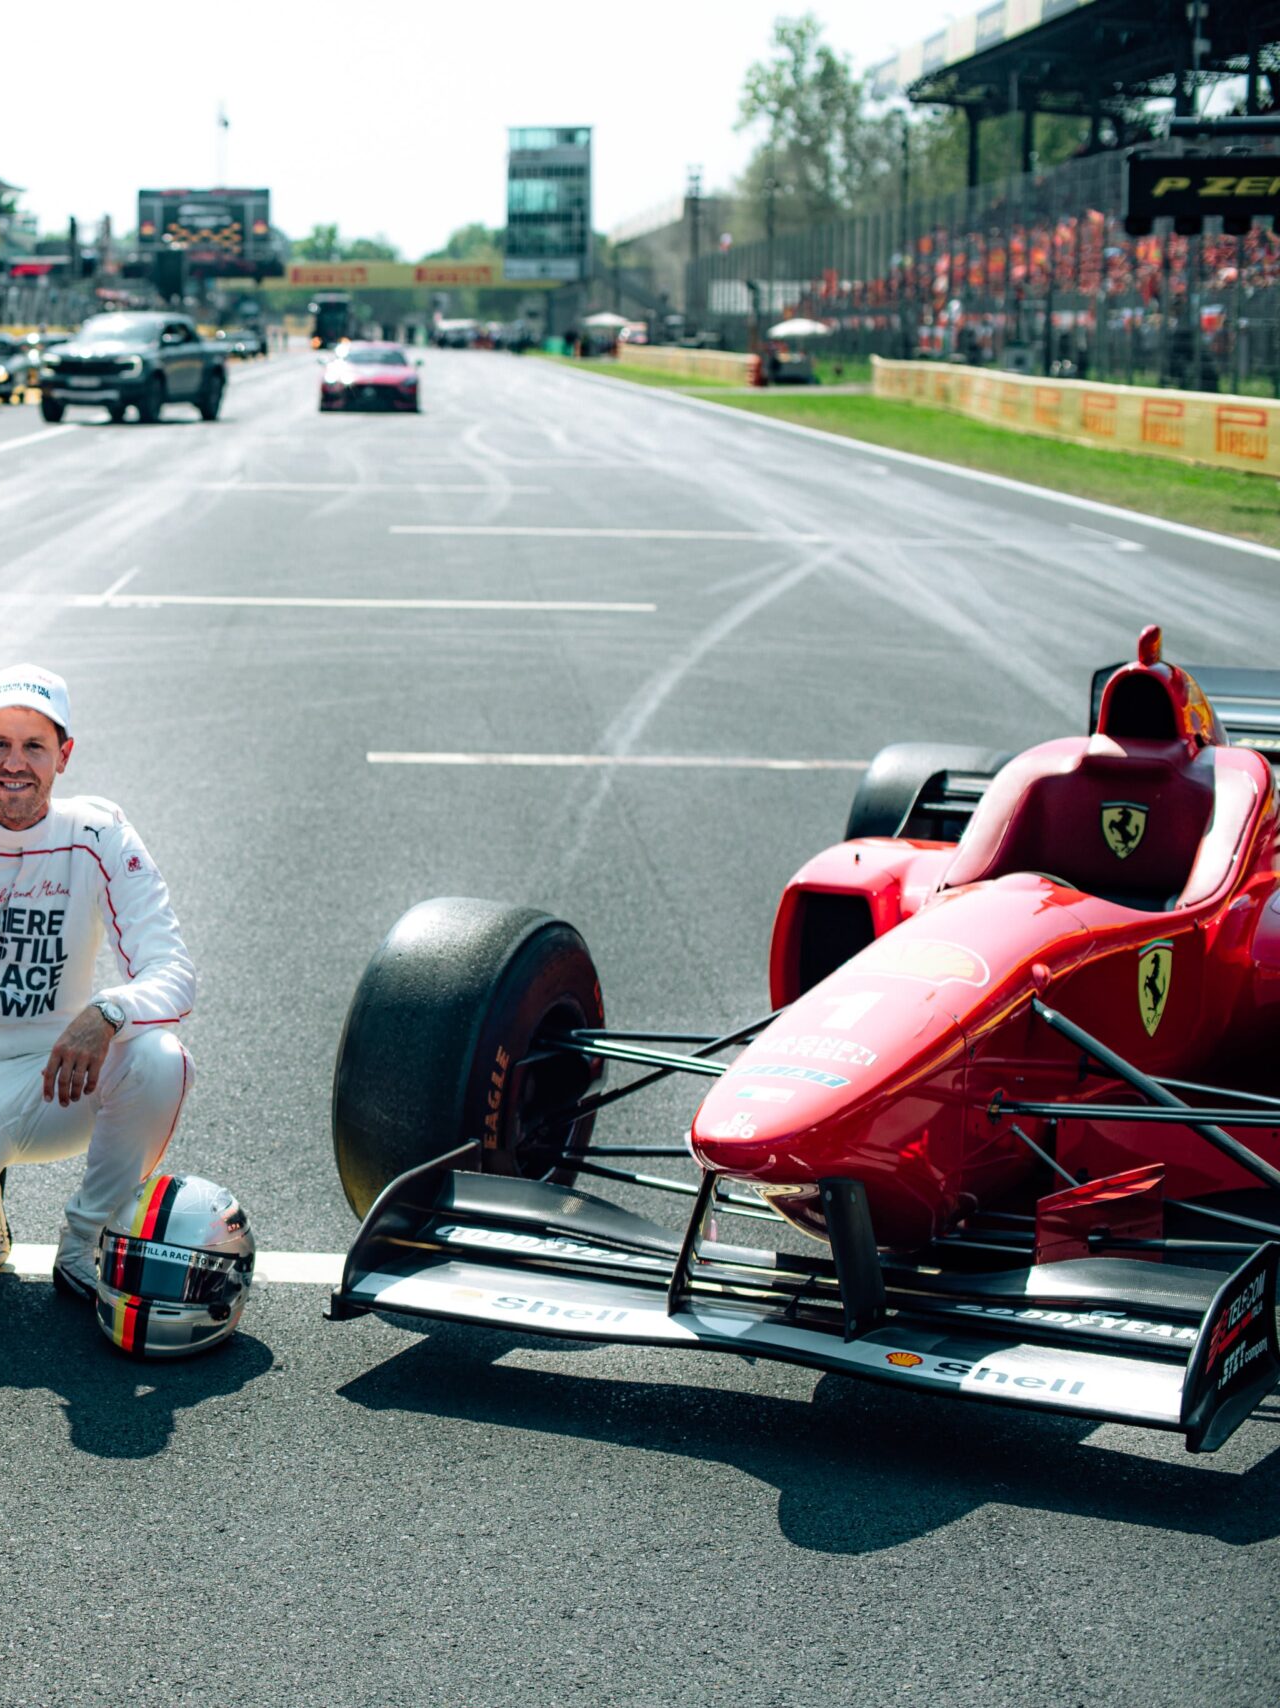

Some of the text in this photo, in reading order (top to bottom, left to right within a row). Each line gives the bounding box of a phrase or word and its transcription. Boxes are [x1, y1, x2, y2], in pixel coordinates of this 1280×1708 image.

[1151, 177, 1191, 197] P
[1215, 405, 1269, 460] PIRELLI
[0, 987, 58, 1017] WIN
[822, 991, 887, 1030] 1
[483, 1044, 510, 1149] EAGLE
[169, 1250, 194, 1262] RACE
[491, 1296, 629, 1322] Shell
[933, 1361, 1086, 1396] Shell
